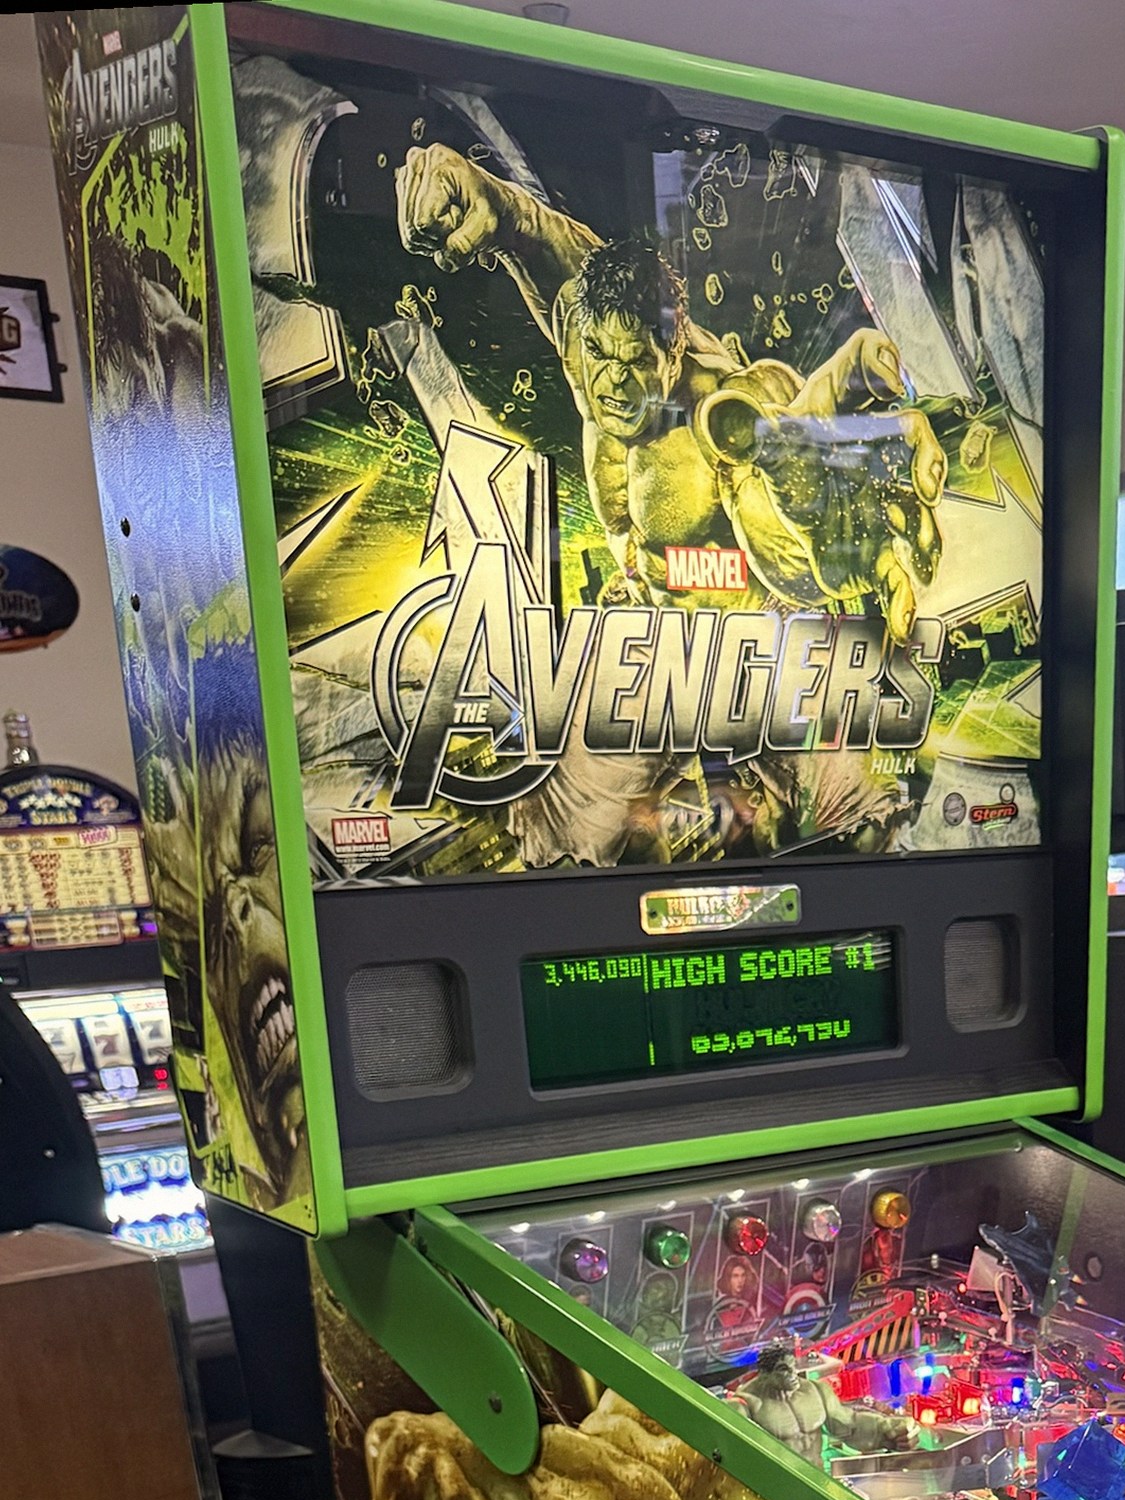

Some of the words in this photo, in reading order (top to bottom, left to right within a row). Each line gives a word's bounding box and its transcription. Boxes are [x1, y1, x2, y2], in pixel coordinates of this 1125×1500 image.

[62, 38, 178, 176] AVENGERS
[149, 122, 179, 153] HULK
[668, 550, 746, 589] MARVEL
[372, 541, 948, 810] AVENGERS
[453, 703, 489, 724] THE
[870, 757, 916, 775] HULK
[972, 806, 1014, 823] Stern
[333, 819, 389, 844] MARVEL
[544, 957, 642, 987] 3,446,090
[652, 954, 725, 989] HIGH
[740, 946, 833, 982] SCORE
[845, 942, 874, 971] #1
[123, 1217, 206, 1247] STARS
